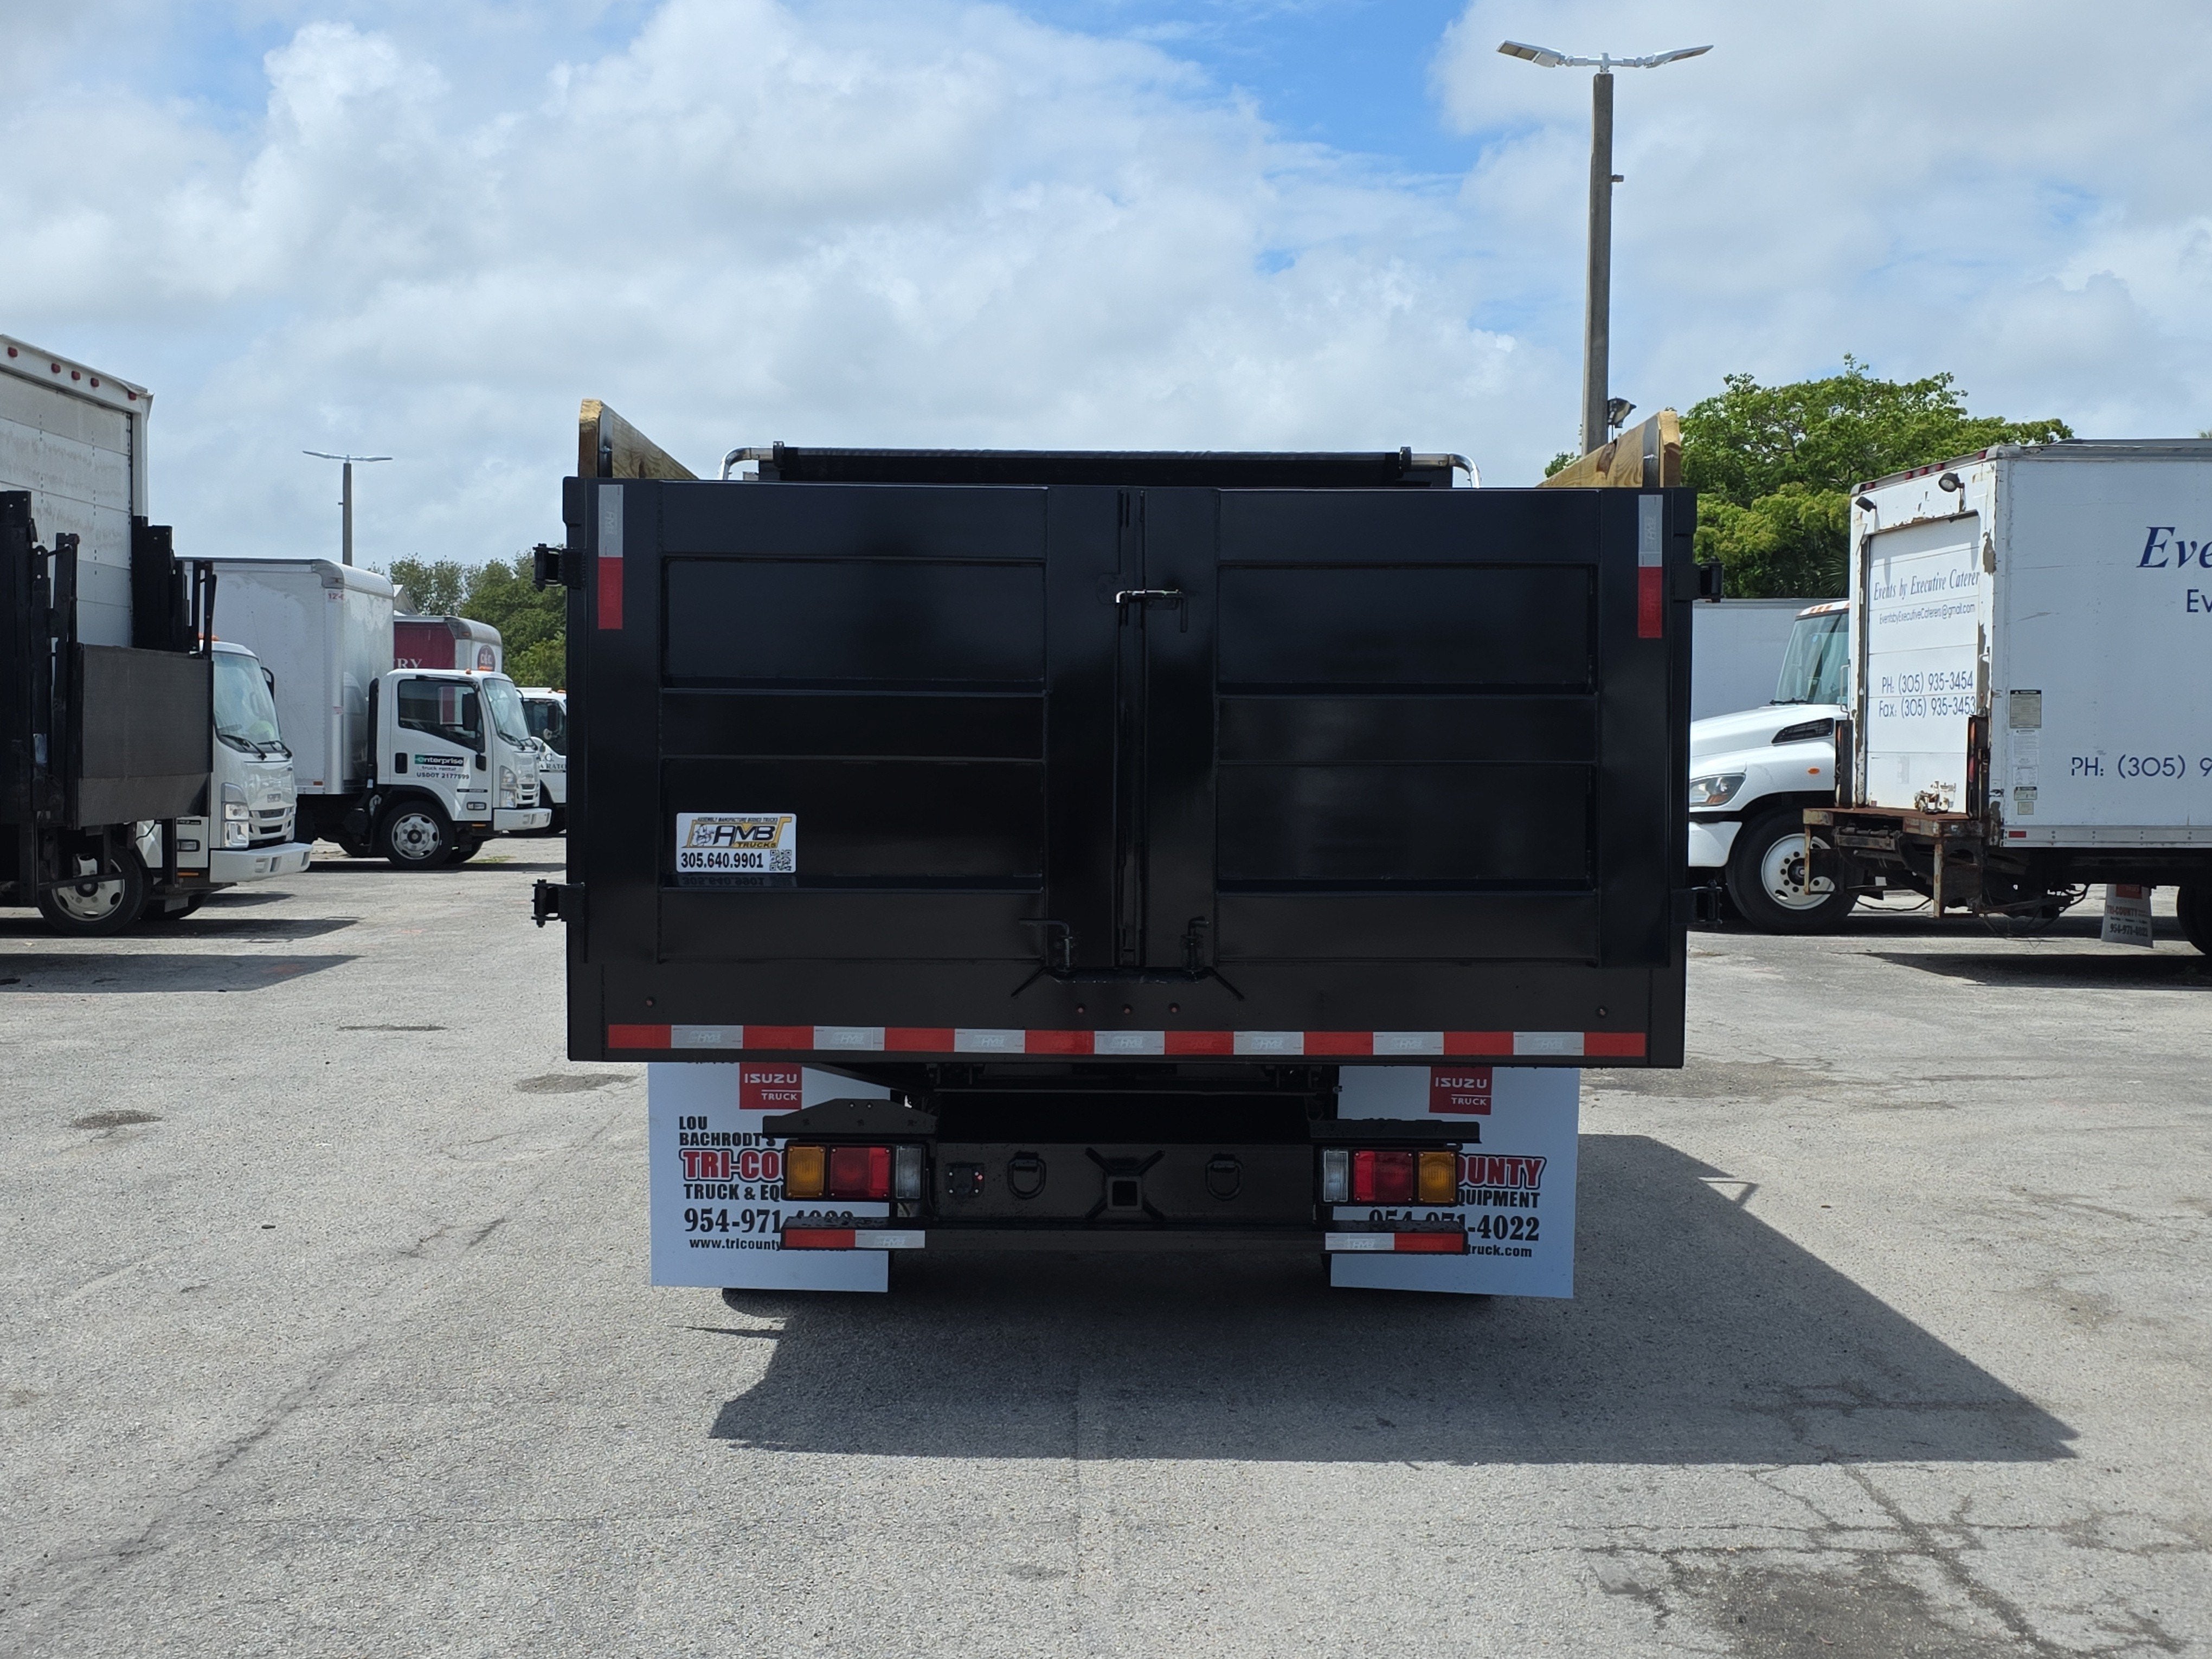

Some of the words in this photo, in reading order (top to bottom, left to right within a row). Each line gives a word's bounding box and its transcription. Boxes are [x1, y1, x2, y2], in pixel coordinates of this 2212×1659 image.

[2136, 526, 2212, 568] Eve
[1874, 582, 1896, 601] Events
[1899, 578, 1907, 600] by
[1911, 572, 1946, 595] Executive
[2187, 589, 2212, 613] Ev
[394, 657, 423, 668] RY
[1882, 676, 1895, 693] PH:
[1899, 671, 1924, 695] (305)
[1928, 670, 1973, 691] 935-3454
[1879, 700, 1897, 717] Fax:
[1901, 696, 1926, 719] (305)
[1931, 696, 1976, 716] 935-3453
[417, 756, 464, 765] enterprise
[2071, 757, 2104, 776] PH:
[2118, 754, 2186, 779] (305)
[712, 825, 776, 847] AMB
[681, 852, 763, 868] 305.640.9901
[744, 1073, 798, 1083] ISUZU
[1435, 1077, 1487, 1089] ISUZU
[761, 1092, 798, 1101] TRUCK
[1451, 1097, 1487, 1106] TRUCK
[679, 1116, 707, 1130] LOU
[680, 1149, 784, 1182] TRI-CO
[684, 1184, 740, 1200] TRUCK
[744, 1186, 756, 1200] &
